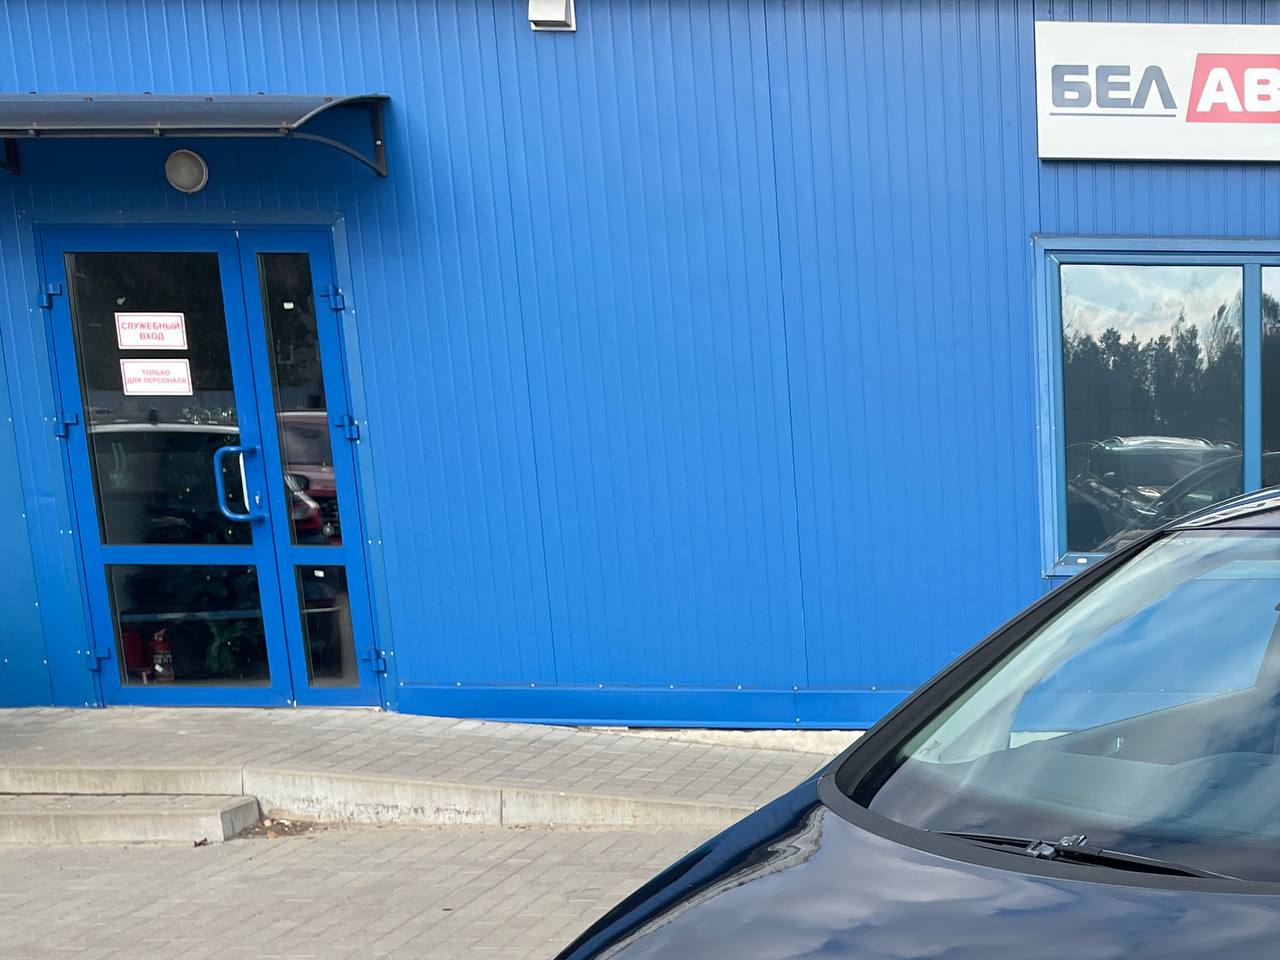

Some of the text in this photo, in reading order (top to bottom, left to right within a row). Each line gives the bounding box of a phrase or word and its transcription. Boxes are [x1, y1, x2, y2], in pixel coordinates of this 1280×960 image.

[1049, 63, 1178, 110] БЕЛ
[121, 321, 181, 331] СЛУЖЕБНЫЙ
[139, 332, 165, 342] ВХОД
